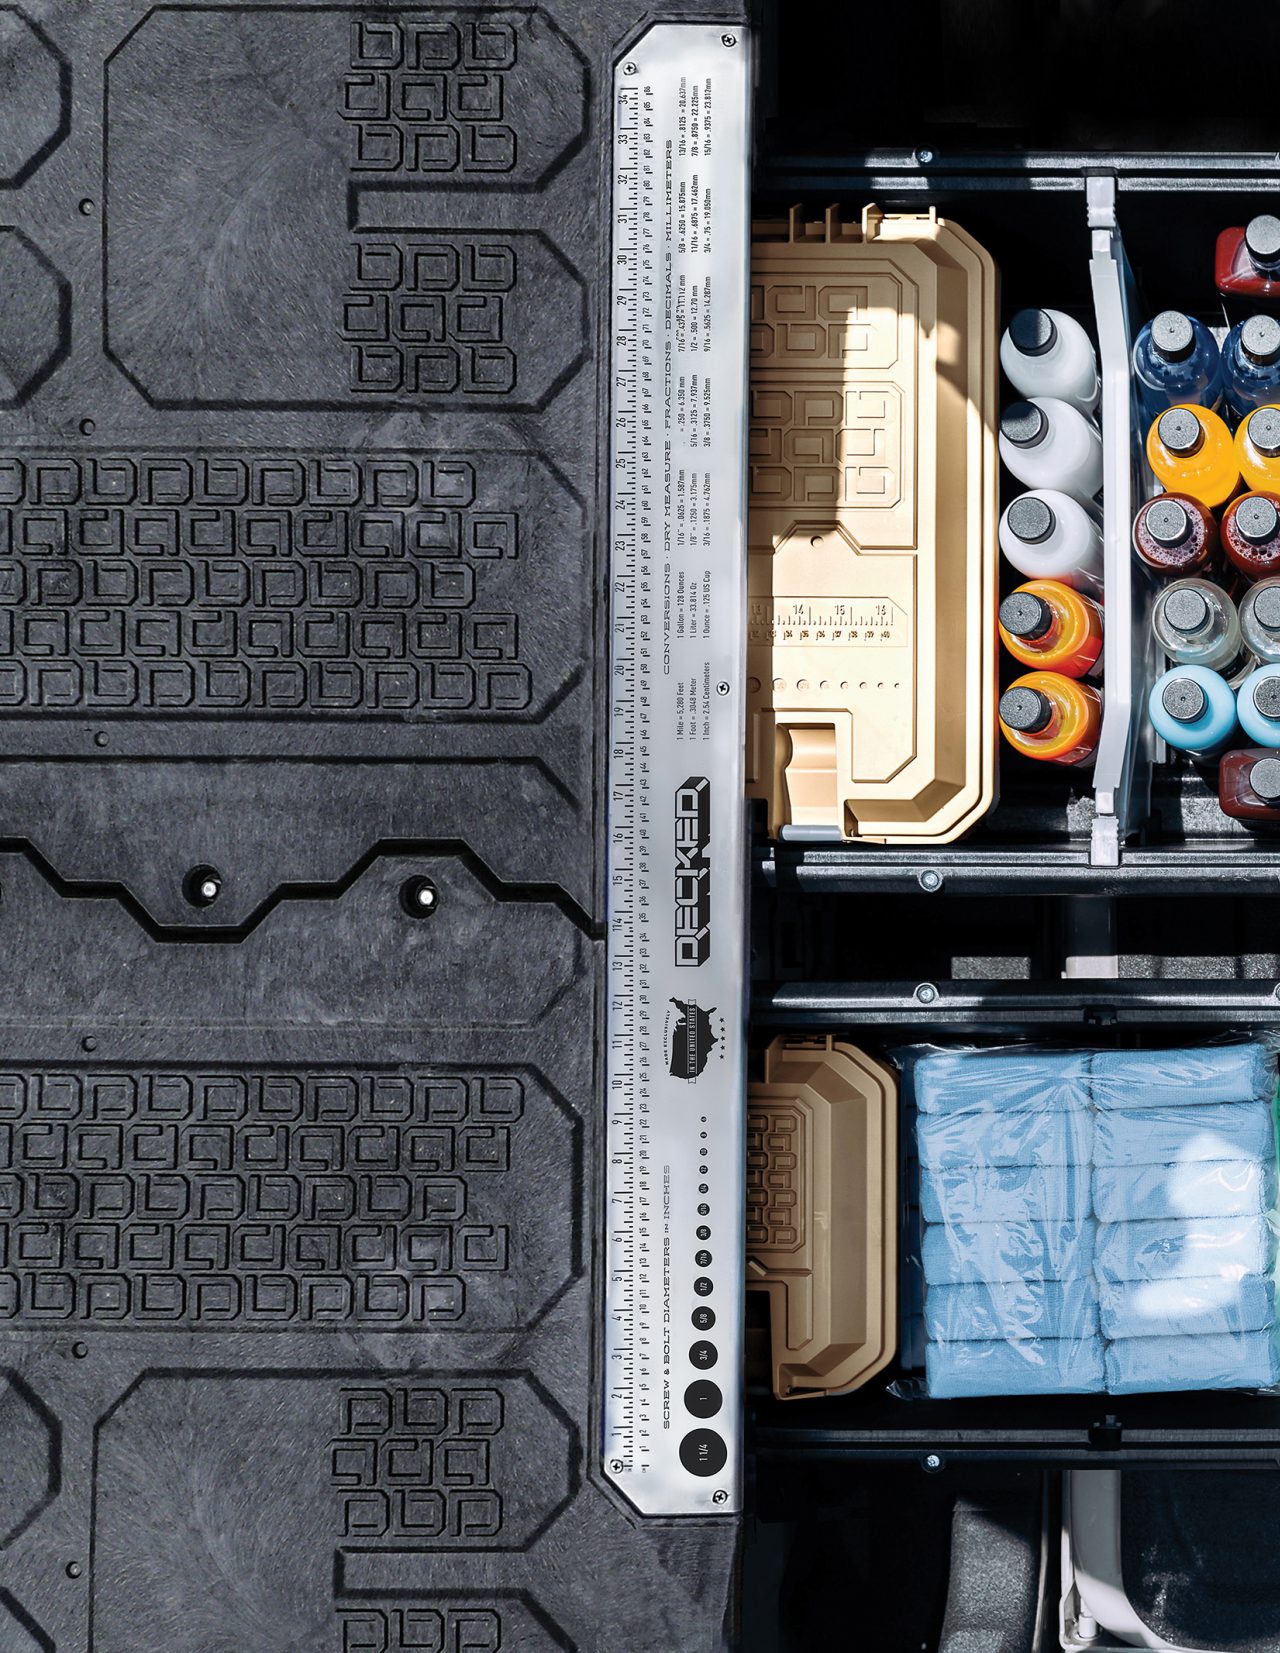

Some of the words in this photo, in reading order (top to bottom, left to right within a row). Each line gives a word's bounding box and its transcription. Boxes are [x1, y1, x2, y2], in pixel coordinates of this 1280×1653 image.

[704, 78, 712, 109] 23.812mm
[618, 94, 628, 105] 34
[691, 85, 699, 116] 22.225mm
[704, 116, 712, 132] .9375
[691, 123, 699, 140] .8750
[618, 134, 628, 145] 33
[691, 146, 699, 157] 7/8
[618, 174, 628, 185] 32
[617, 214, 627, 224] 31
[617, 254, 627, 265] 30
[616, 295, 627, 306] 29
[616, 336, 626, 346] 28
[616, 376, 626, 387] 27
[703, 377, 711, 406] 9.525mm
[616, 417, 626, 428] 26
[690, 409, 698, 426] .3125
[703, 413, 711, 430] .3750
[690, 433, 698, 447] 5/16
[703, 437, 711, 447] 3/8
[616, 458, 626, 469] 25
[677, 469, 685, 497] 1.587mm
[703, 472, 711, 501] 4.762mm
[615, 500, 625, 510] 24
[677, 504, 685, 522] .0625
[615, 541, 625, 551] 23
[703, 570, 712, 583] Cup
[615, 582, 625, 593] 22
[703, 584, 710, 592] US
[793, 605, 804, 614] 14
[835, 605, 845, 615] 15
[615, 623, 625, 633] 21
[614, 665, 625, 676] 20
[702, 662, 710, 699] Centimeters
[689, 678, 697, 696] Meter
[677, 697, 685, 714] 5,280
[689, 697, 697, 714] .3048
[702, 700, 710, 714] 2.54
[614, 707, 624, 717] 19
[689, 721, 697, 735] Foot
[702, 721, 710, 735] Inch
[614, 749, 624, 759] 18
[613, 791, 624, 801] 17
[613, 833, 623, 844] 16
[675, 777, 710, 967] DECKED
[612, 875, 623, 886] 15
[612, 961, 623, 971] 13
[612, 1001, 623, 1011] 12
[663, 1009, 671, 1047] EXCLUSIVELY
[612, 1040, 622, 1049] 11
[612, 1080, 622, 1090] 10
[699, 1252, 707, 1264] 7/16
[699, 1282, 708, 1291] 1/2
[699, 1313, 708, 1324] 5/8
[699, 1350, 708, 1361] 3/4
[699, 1444, 708, 1455] 1/4
